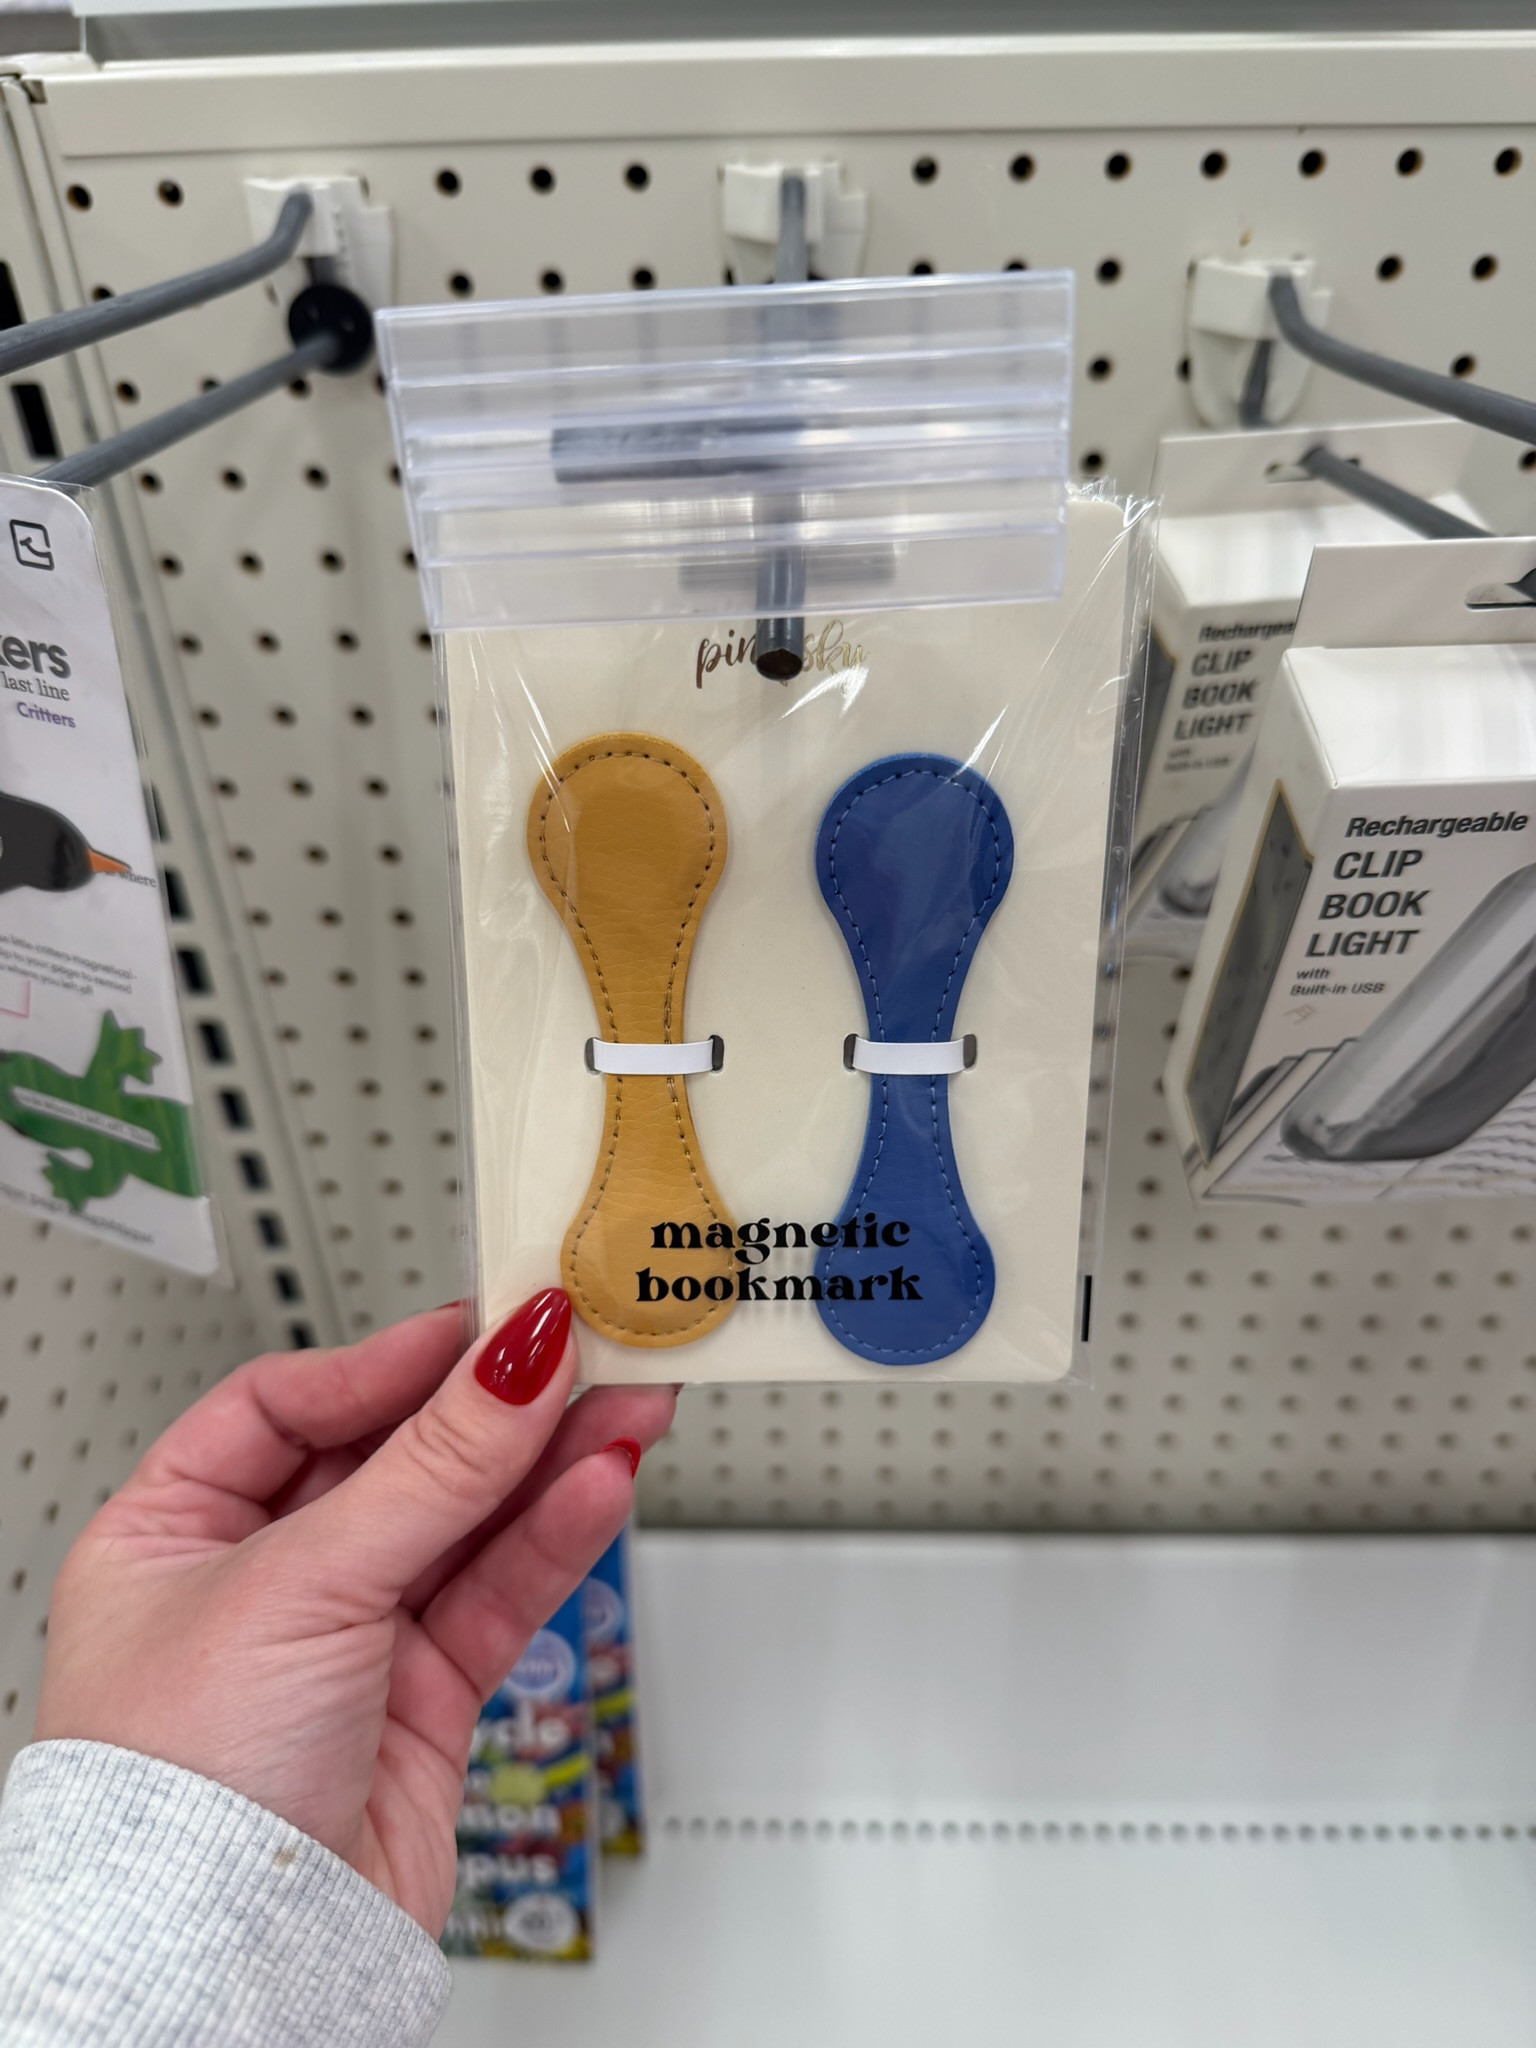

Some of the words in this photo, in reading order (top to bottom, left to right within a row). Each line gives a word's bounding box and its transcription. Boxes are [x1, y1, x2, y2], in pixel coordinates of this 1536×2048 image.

[0, 634, 71, 679] ers
[1192, 649, 1253, 676] CLIP
[1, 671, 34, 694] last
[36, 678, 70, 701] line
[1183, 679, 1259, 709] BOOK
[16, 701, 76, 728] Critters
[1174, 713, 1253, 740] LIGHT
[1345, 811, 1529, 838] Rechargeable
[1333, 850, 1423, 880] CLIP
[1318, 890, 1431, 920] BOOK
[1305, 930, 1420, 958] LIGHT
[1296, 968, 1331, 980] with
[1289, 982, 1347, 996] Built-in
[1351, 982, 1385, 994] USB
[650, 1212, 910, 1265] magnetic
[635, 1265, 923, 1302] bookmark
